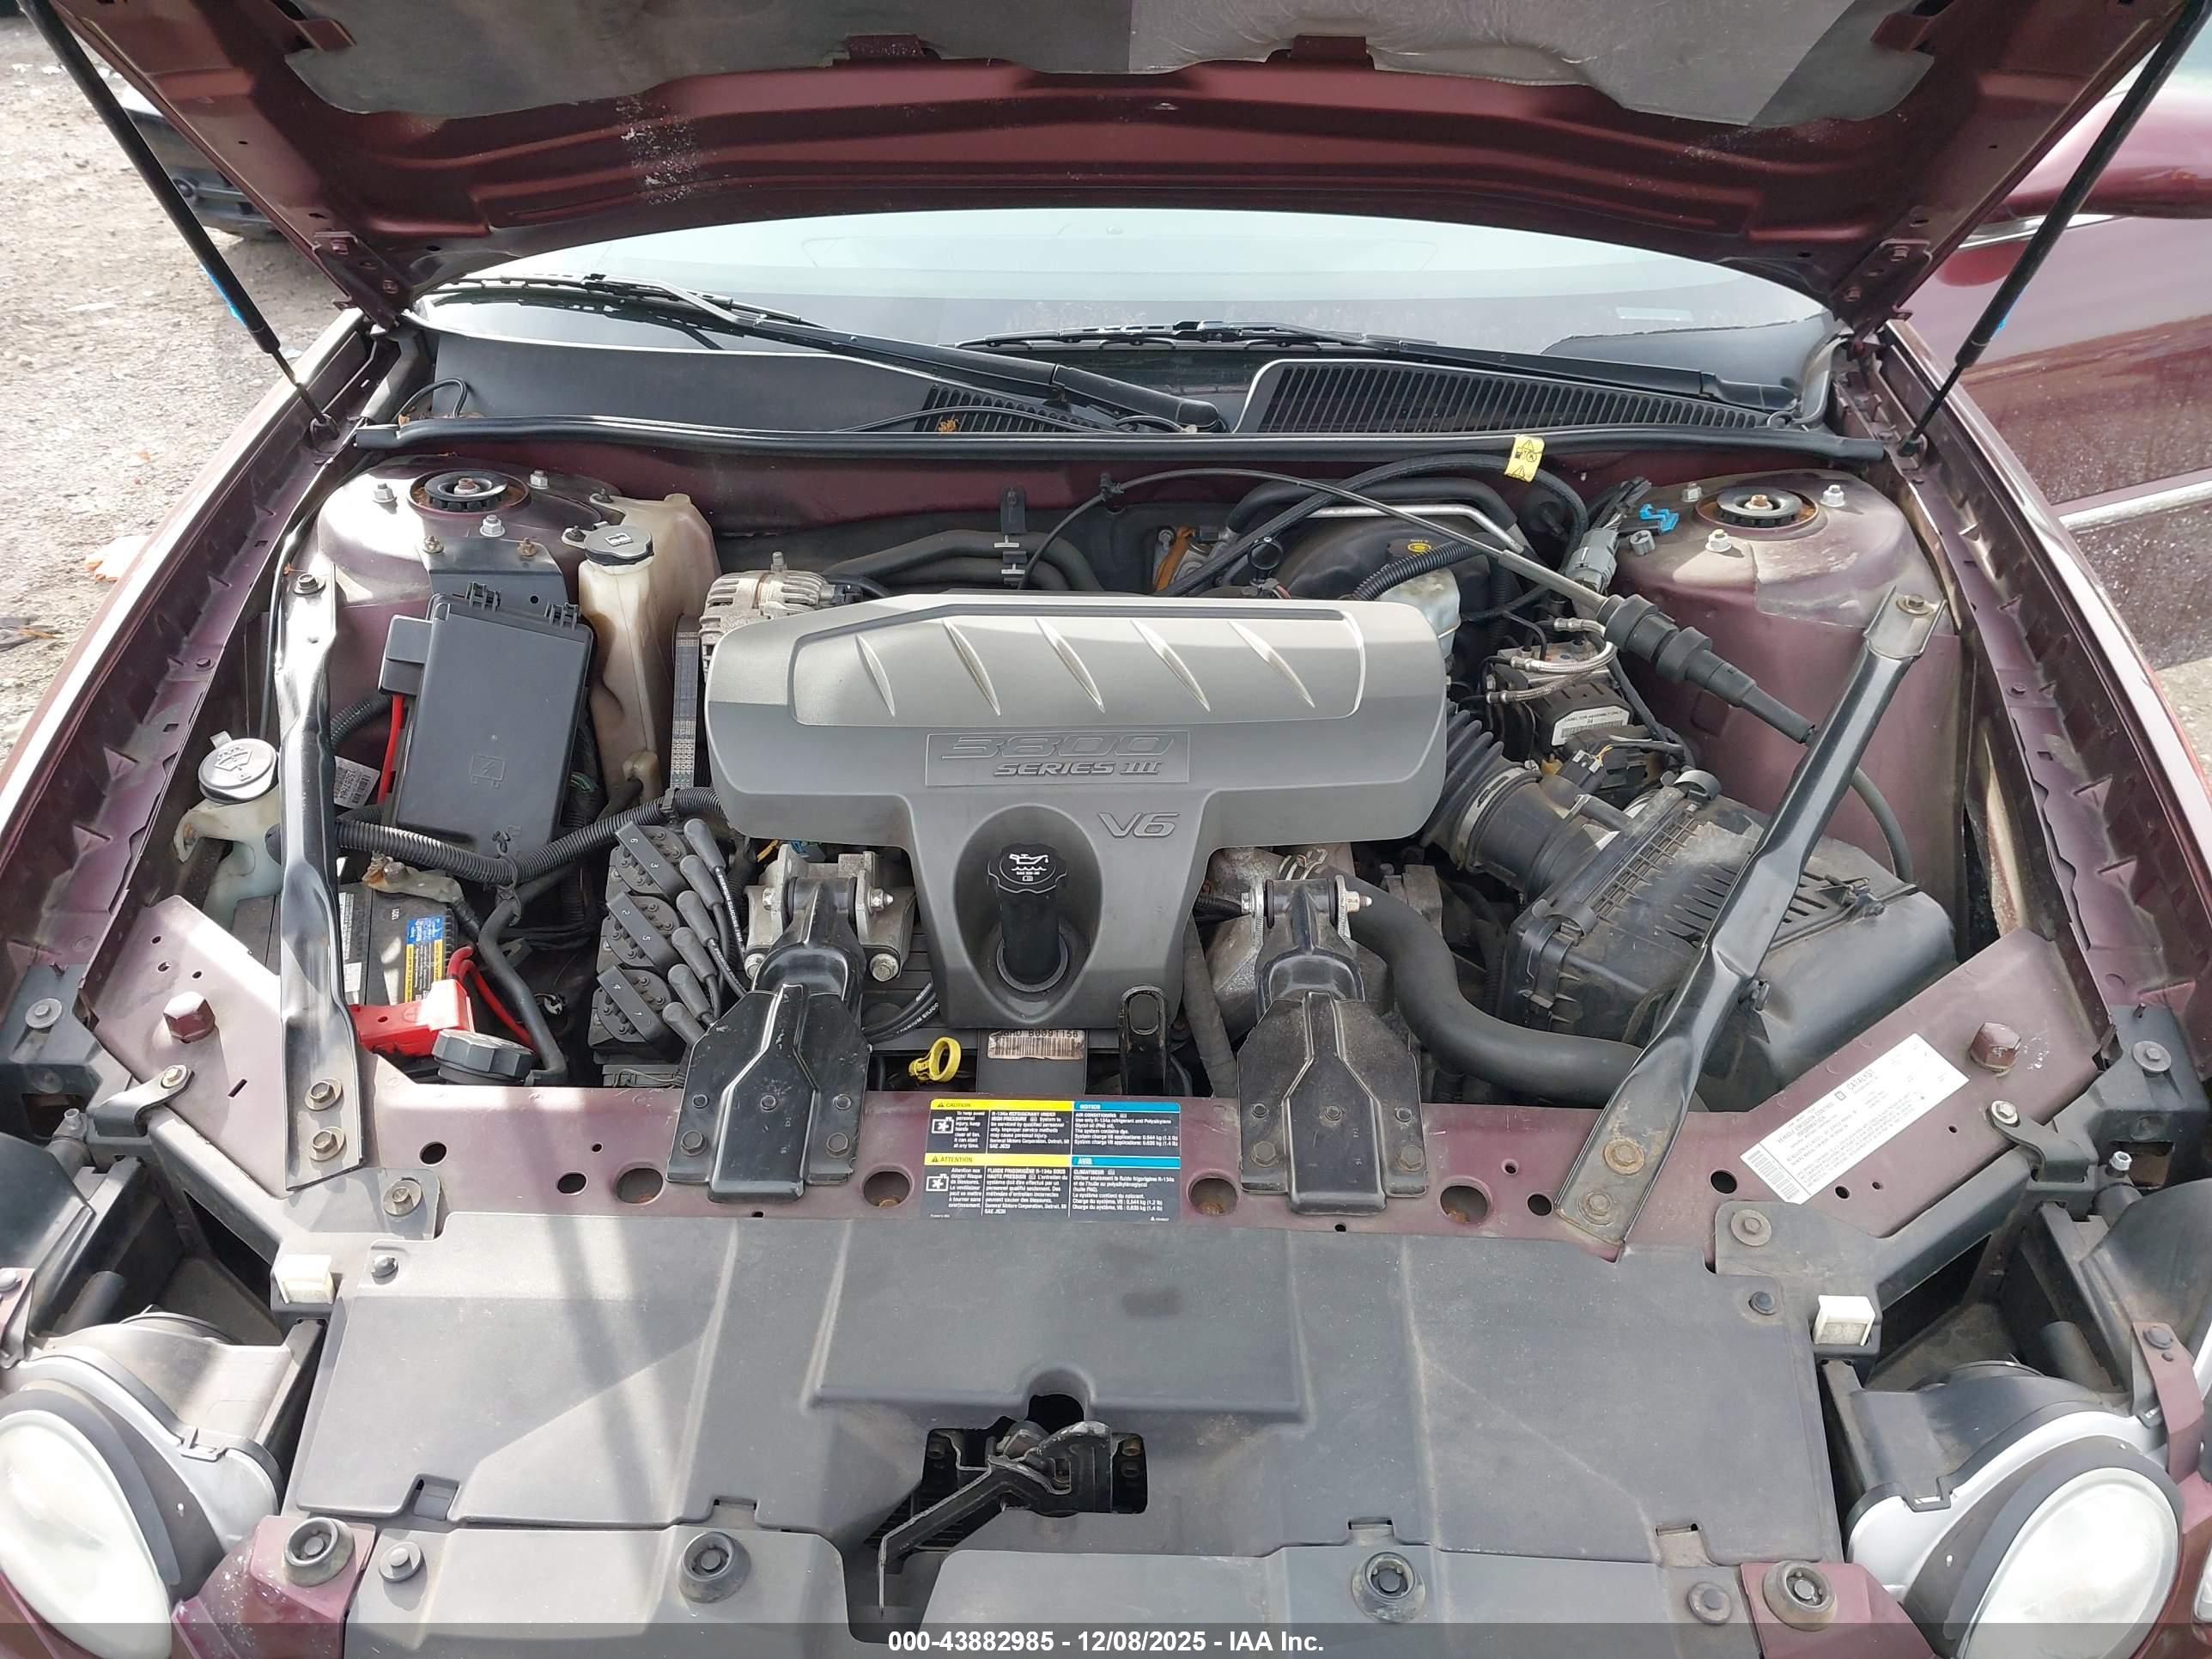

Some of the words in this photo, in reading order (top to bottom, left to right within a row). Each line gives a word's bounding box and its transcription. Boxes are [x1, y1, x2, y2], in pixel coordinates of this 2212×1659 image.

[994, 761, 1116, 776] SERIES
[1119, 760, 1162, 775] III
[1097, 812, 1181, 839] V6
[650, 861, 659, 870] 3
[718, 873, 731, 902] PREMIUM
